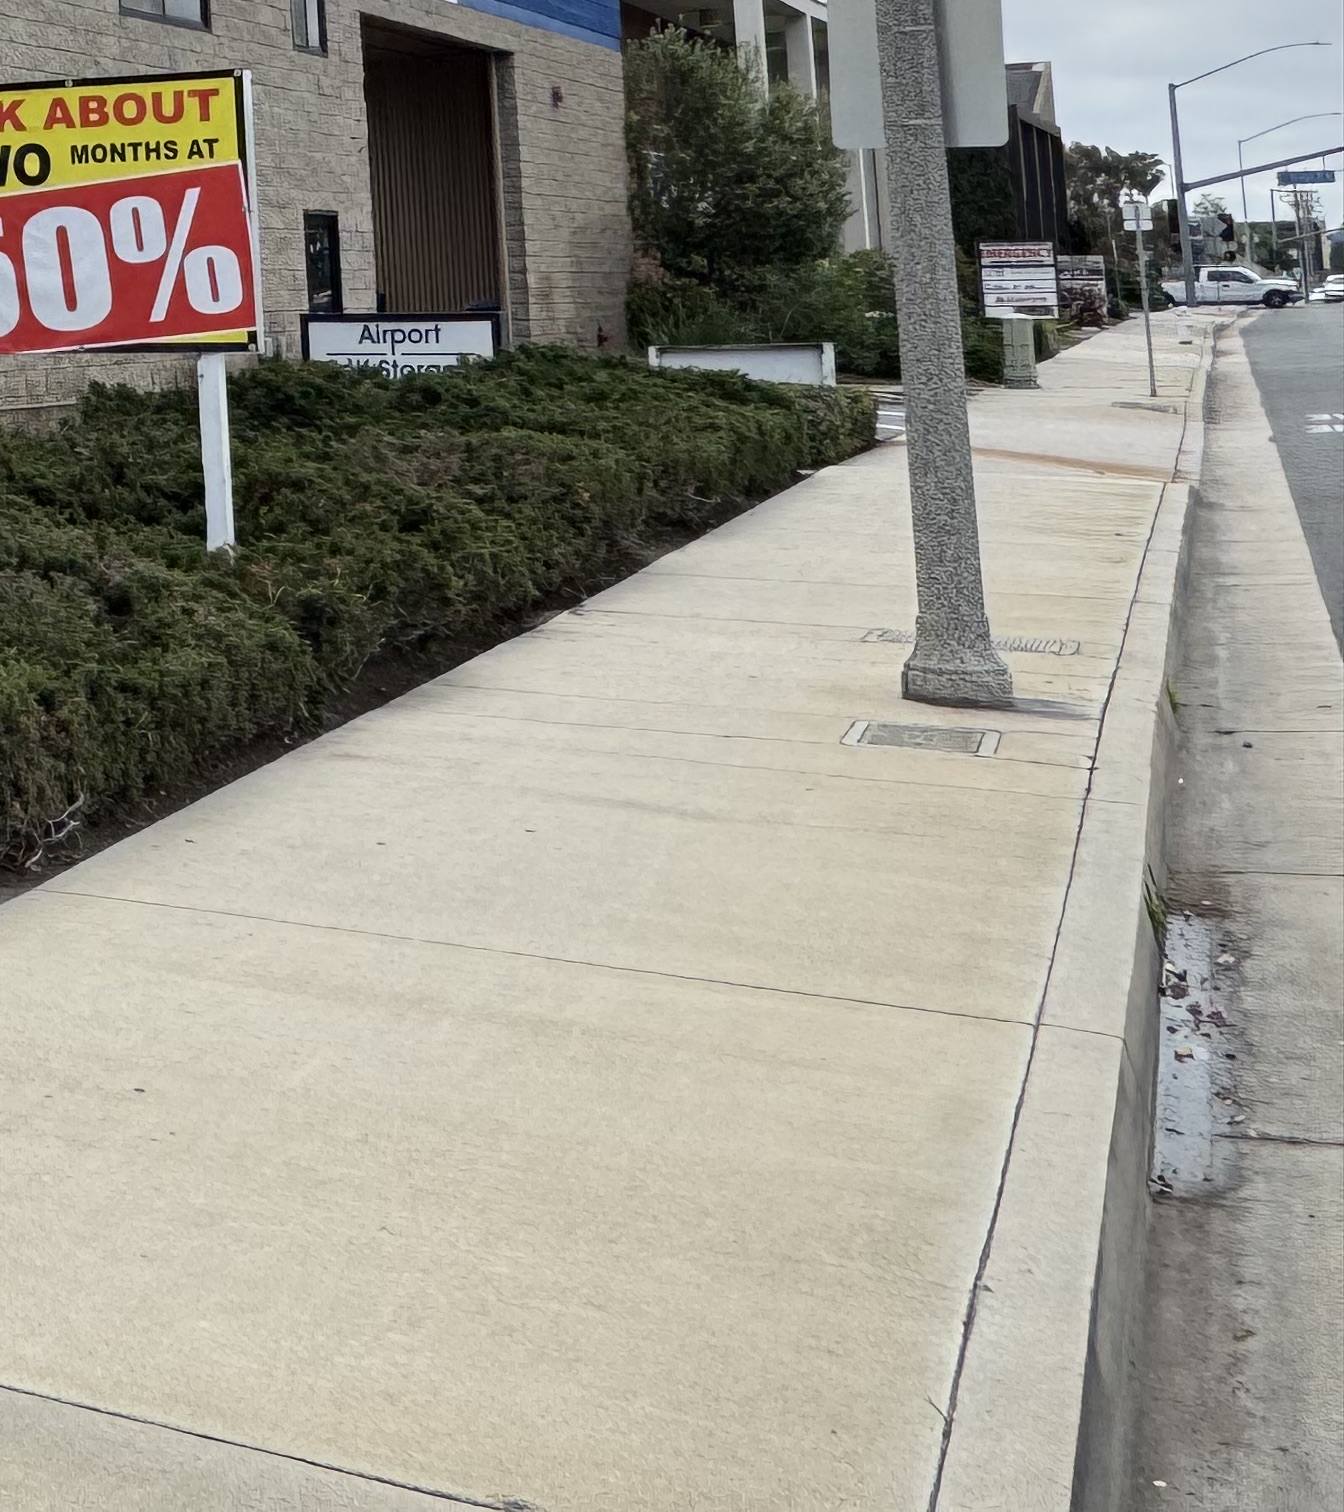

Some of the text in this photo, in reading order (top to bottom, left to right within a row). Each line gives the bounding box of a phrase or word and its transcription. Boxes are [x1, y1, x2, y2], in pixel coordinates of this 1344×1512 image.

[43, 88, 220, 131] ABOUT
[70, 140, 179, 165] MONTHS
[187, 138, 220, 160] AT
[358, 323, 442, 356] Airport
